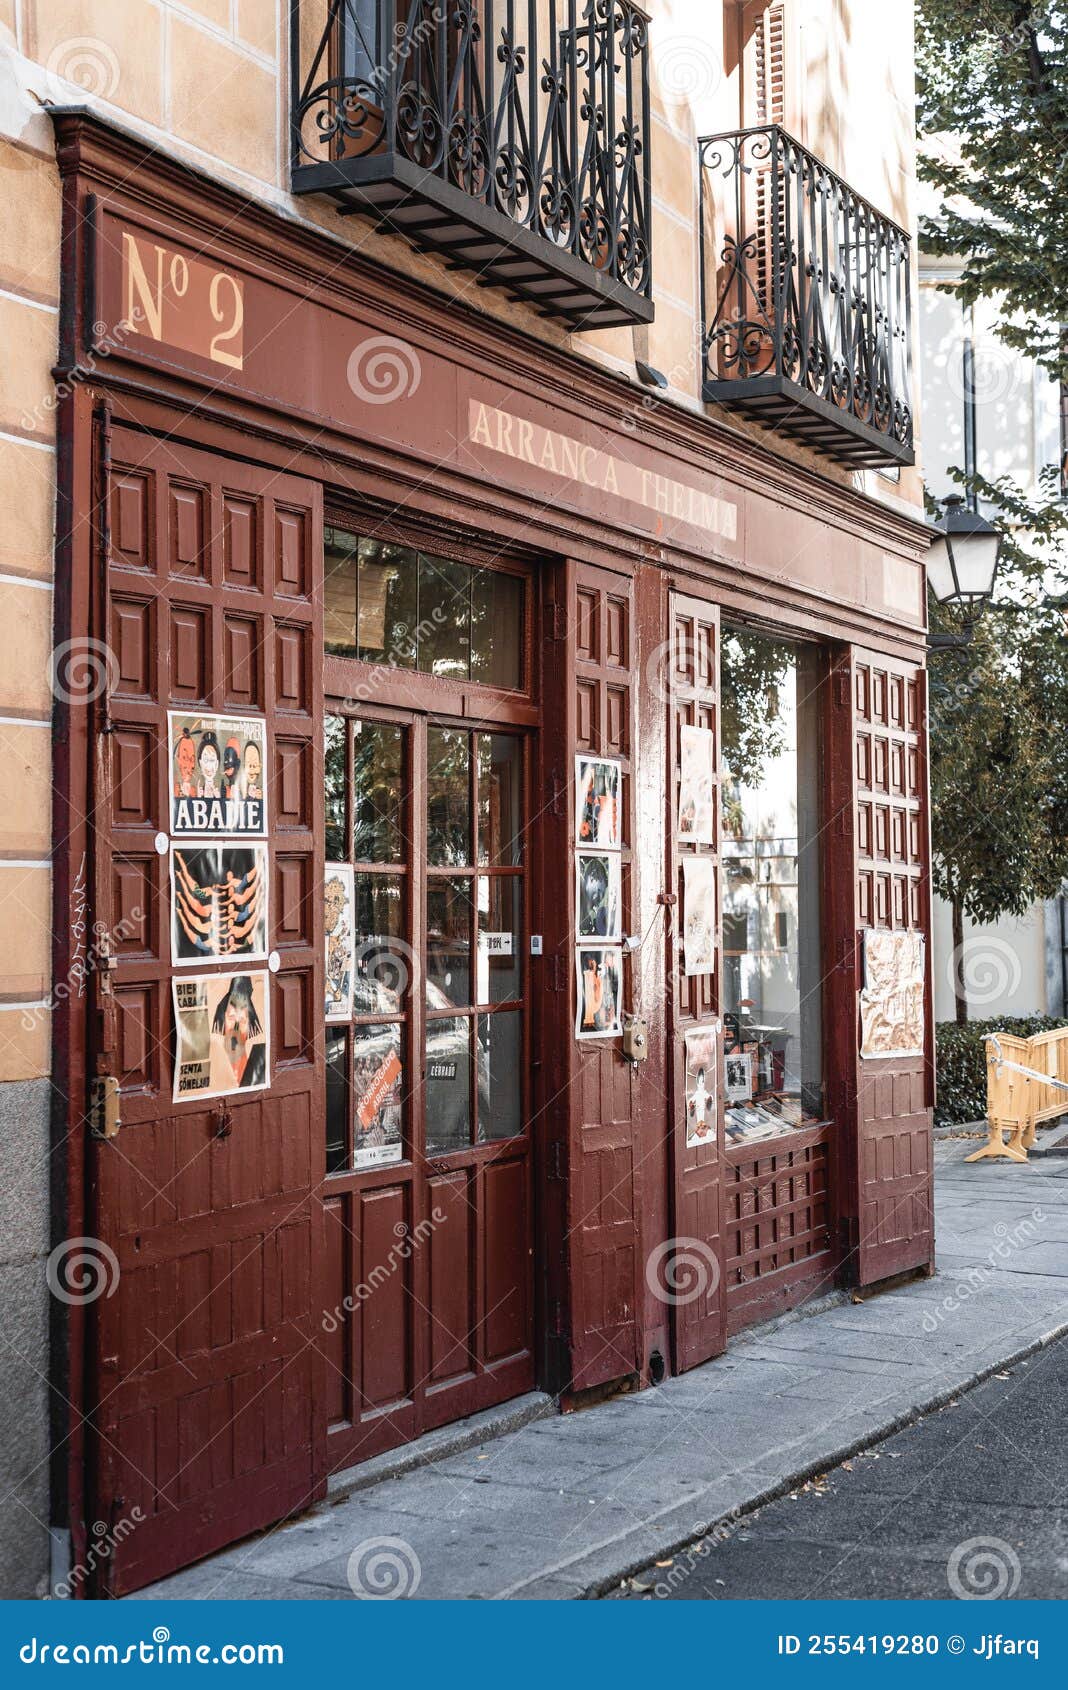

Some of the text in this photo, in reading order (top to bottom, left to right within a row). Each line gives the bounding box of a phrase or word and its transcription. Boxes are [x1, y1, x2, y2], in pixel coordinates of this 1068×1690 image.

[210, 272, 243, 370] 2
[635, 466, 737, 541] THELMA
[175, 799, 261, 830] ABADIE
